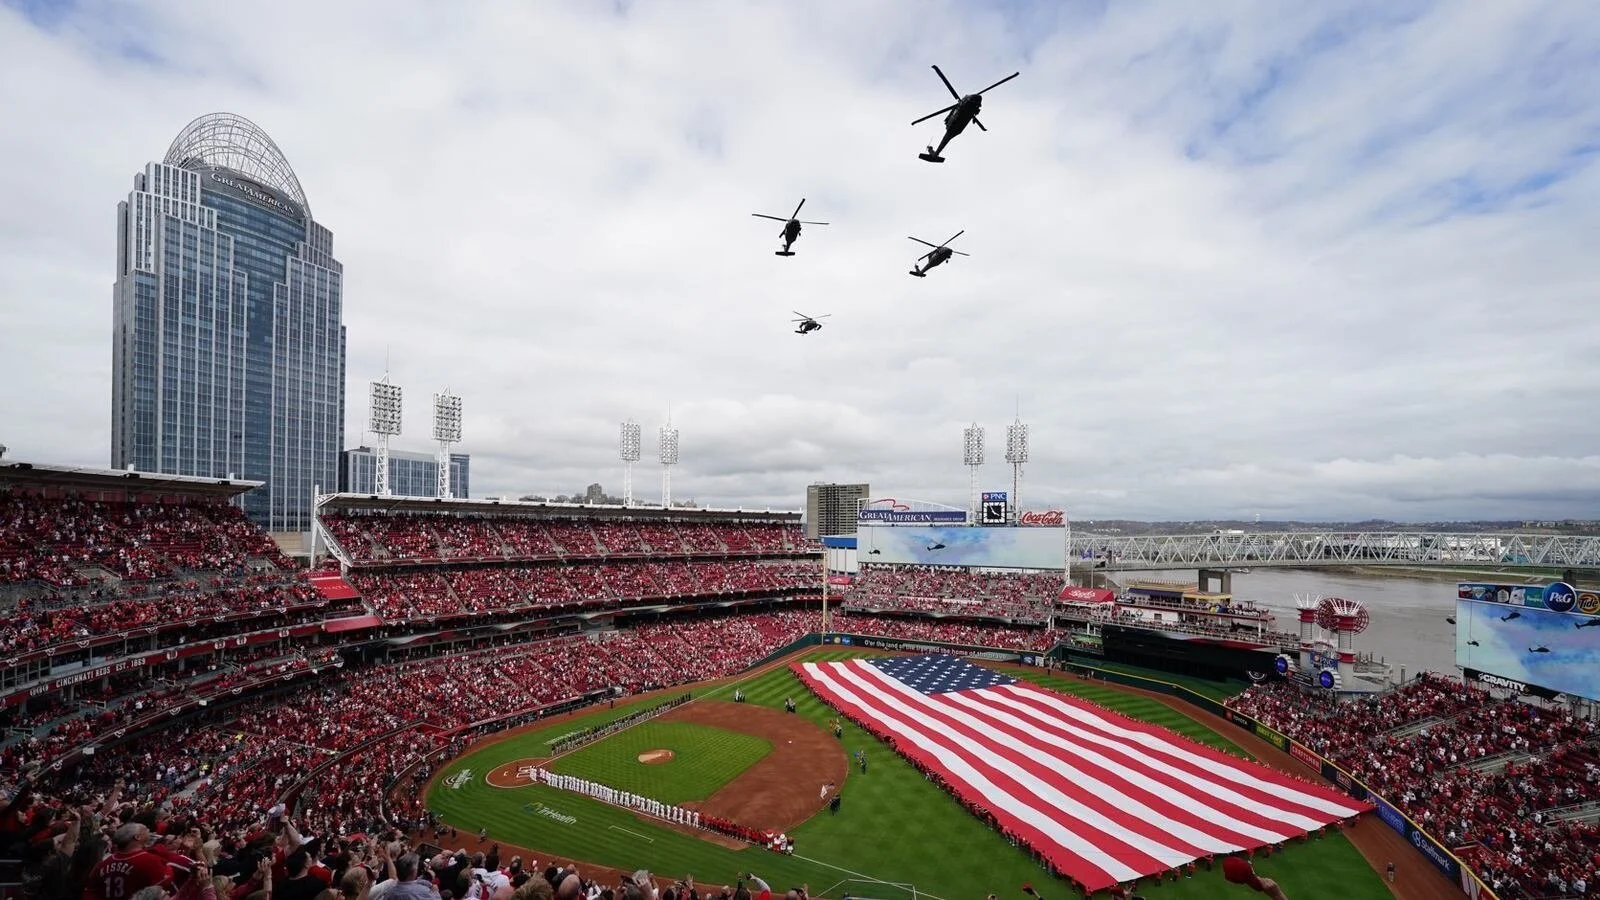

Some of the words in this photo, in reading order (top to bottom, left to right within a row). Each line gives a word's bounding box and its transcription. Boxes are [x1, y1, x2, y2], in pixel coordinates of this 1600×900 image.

[1549, 592, 1572, 603] P&G
[1579, 597, 1598, 609] Tide
[55, 672, 94, 688] CINCINNATI
[95, 666, 111, 678] REDS
[115, 662, 129, 672] EST.
[1484, 674, 1526, 692] GRAVITY
[104, 876, 125, 899] 13
